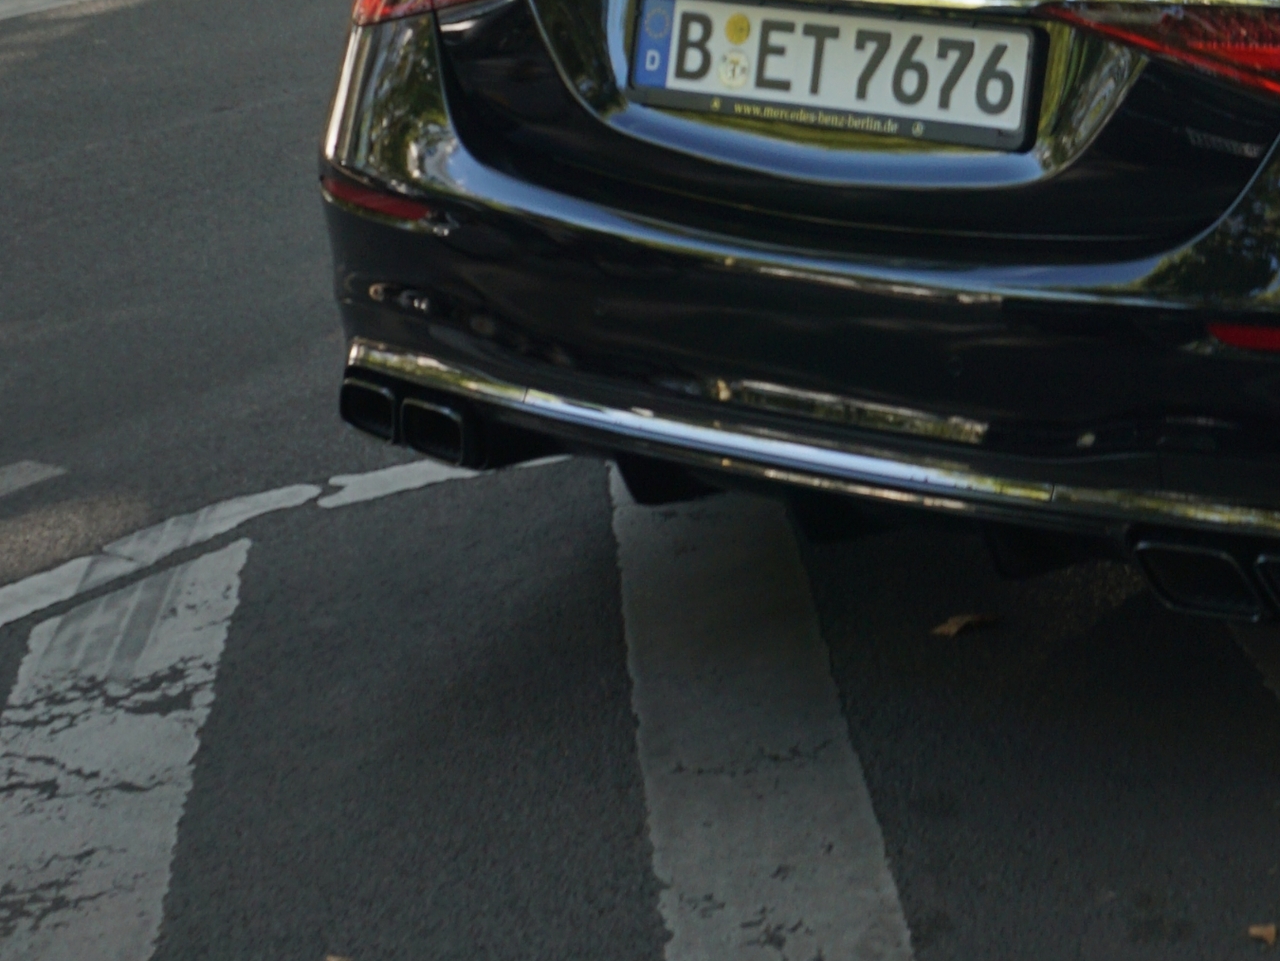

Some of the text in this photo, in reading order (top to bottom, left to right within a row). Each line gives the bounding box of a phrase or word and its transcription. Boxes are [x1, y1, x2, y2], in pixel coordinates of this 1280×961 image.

[645, 49, 660, 71] D
[675, 12, 713, 80] B
[733, 102, 898, 133] www.mercedes-benz-berlin.de
